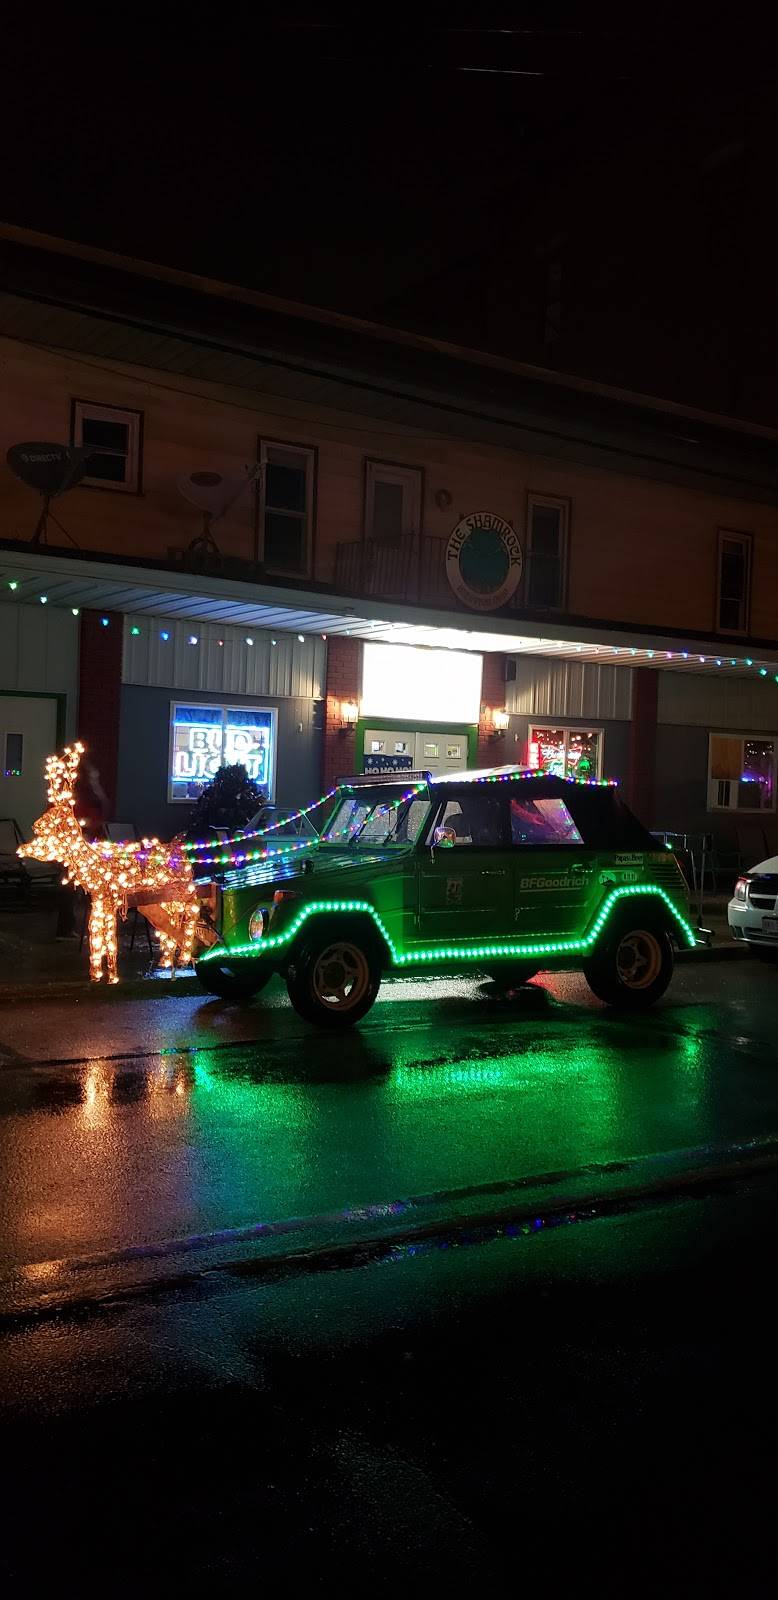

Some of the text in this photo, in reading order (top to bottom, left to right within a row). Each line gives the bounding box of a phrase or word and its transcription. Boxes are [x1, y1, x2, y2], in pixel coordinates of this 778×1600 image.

[448, 514, 522, 567] THE SHAMROCK
[190, 727, 253, 754] BUD
[364, 767, 380, 775] HO
[519, 876, 589, 889] BFGoodrich
